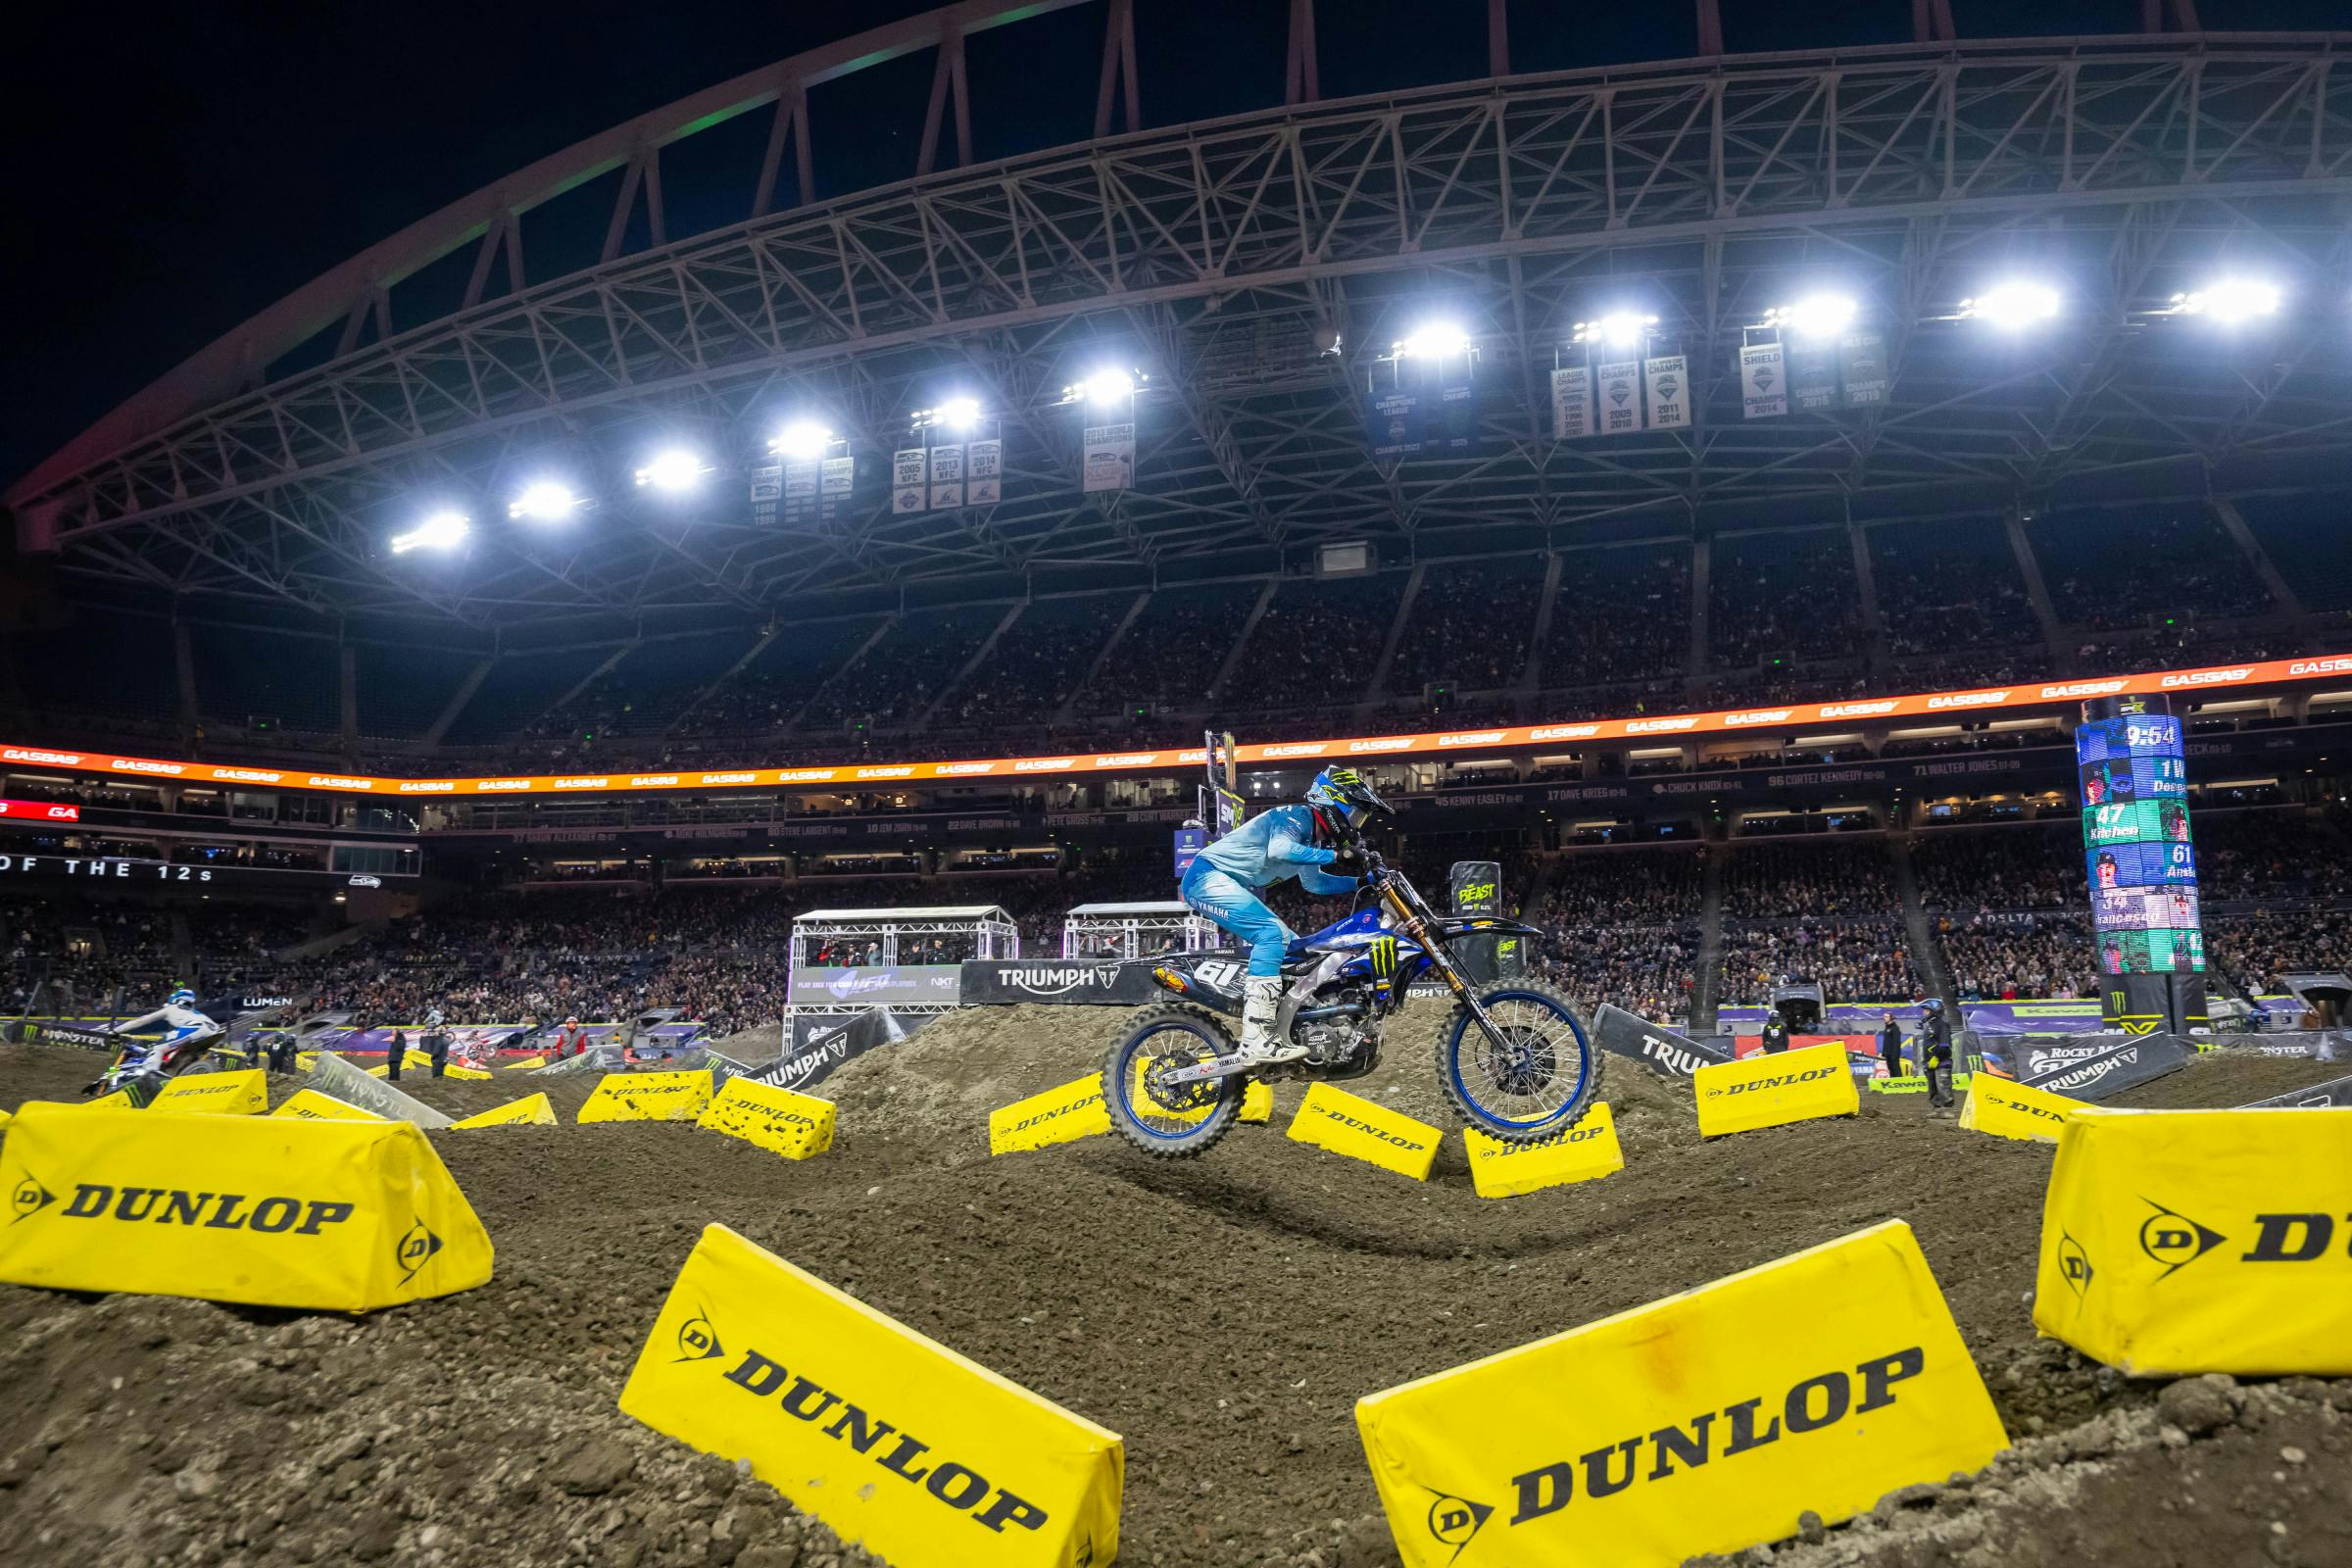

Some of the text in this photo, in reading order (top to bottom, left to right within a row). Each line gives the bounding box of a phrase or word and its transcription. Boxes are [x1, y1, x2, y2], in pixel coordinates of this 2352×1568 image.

[1743, 354, 1780, 366] SHIELD
[1648, 364, 1683, 374] CHAMPS
[1657, 404, 1679, 414] 2011
[1658, 414, 1680, 423] 2014
[936, 461, 958, 470] 2013
[973, 456, 996, 466] 2014
[899, 465, 921, 475] 2005
[939, 469, 956, 479] NFC
[2127, 726, 2175, 746] 9:54
[1913, 765, 1928, 776] 71
[1928, 762, 1965, 774] WALTER
[1968, 760, 1997, 772] JONES
[1768, 775, 1785, 786] 96
[1786, 773, 1819, 785] CORTEZ
[1820, 770, 1863, 783] KENNEDY
[1547, 790, 1560, 800] 17
[1560, 789, 1582, 800] DAVE
[1583, 787, 1608, 799] KRIEG
[1668, 782, 1697, 793] CHUCK
[1698, 781, 1723, 792] KNOX
[1435, 796, 1449, 807] 45
[1449, 795, 1476, 806] KENNY
[1477, 794, 1506, 805] EASLEY
[1048, 814, 1090, 825] PETE GROSS
[2095, 804, 2125, 824] 47
[867, 823, 878, 833] 10
[949, 820, 959, 830] 22
[2090, 826, 2139, 840] Kitchen
[2173, 844, 2191, 864] 61
[66, 859, 130, 877] THE
[158, 866, 212, 881] 12s
[1458, 884, 1495, 905] BEAST
[1198, 901, 1229, 919] YAMAHA
[1497, 941, 1517, 952] EAST
[998, 969, 1094, 989] TRIUMPH
[1195, 961, 1240, 986] 61
[931, 977, 955, 986] NXT
[243, 998, 293, 1007] LUMEN
[1642, 1035, 1710, 1075] TRIU
[2050, 1048, 2096, 1059] ROCKY
[1727, 1066, 1837, 1096] DUNLOP
[173, 1084, 239, 1098] DUNLOP
[613, 1085, 691, 1096] DUNLOP
[734, 1100, 814, 1125] DUNLOP
[1014, 1094, 1102, 1132] DUNLOP
[1326, 1110, 1425, 1152] DUNLOP
[62, 1183, 355, 1235] DUNLOP
[2240, 1213, 2352, 1262] D
[723, 1348, 1049, 1534] DUNLOP
[1510, 1347, 1925, 1527] DUNLOP
